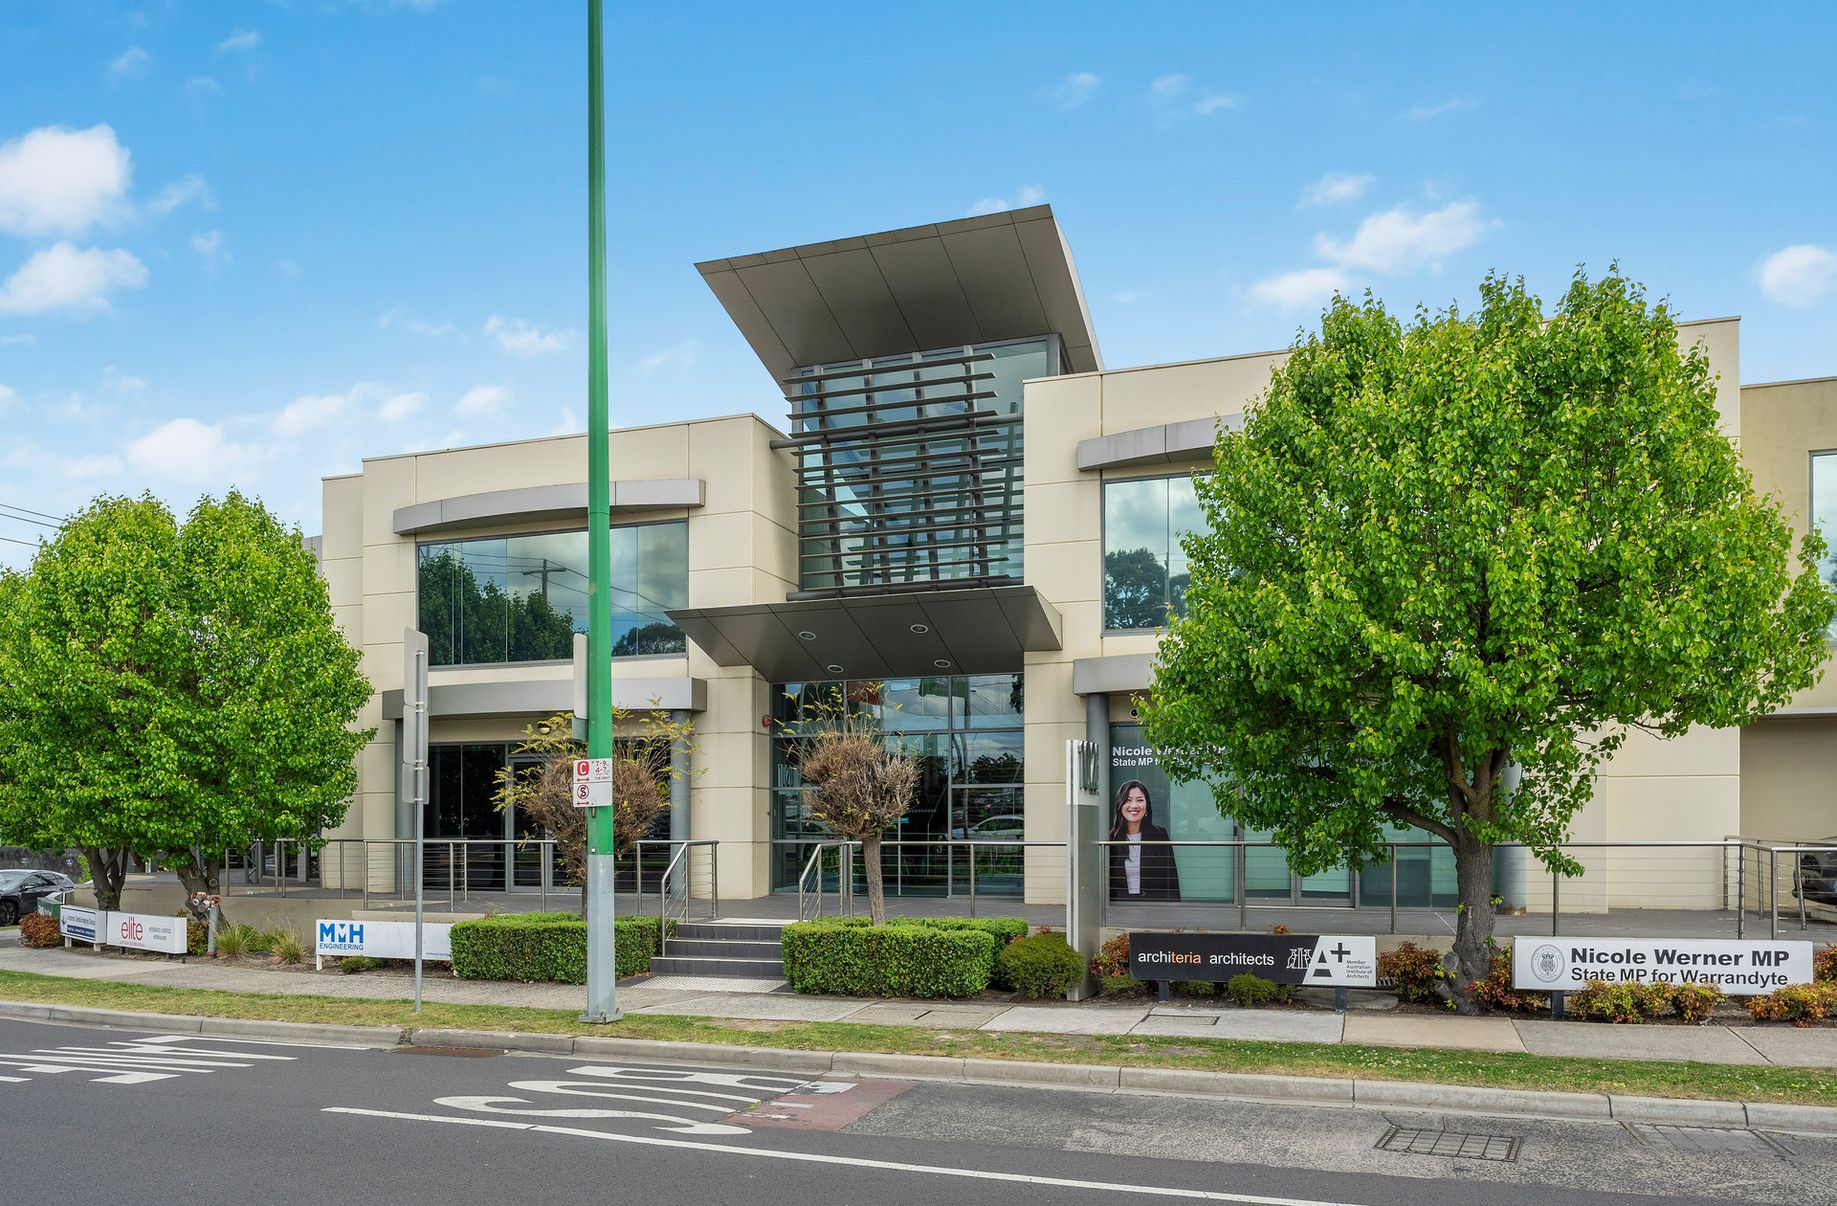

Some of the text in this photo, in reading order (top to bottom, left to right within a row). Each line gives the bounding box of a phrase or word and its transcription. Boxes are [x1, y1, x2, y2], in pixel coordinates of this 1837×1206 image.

[1112, 746, 1153, 756] Nicole
[1112, 757, 1137, 767] State
[1138, 757, 1153, 766] MP
[121, 916, 144, 941] elite
[319, 943, 364, 951] ENGINEERING
[1138, 951, 1275, 966] architeria architects
[1571, 947, 1647, 965] Nicole
[1654, 949, 1744, 966] Werner
[1751, 950, 1790, 967] MP
[1571, 967, 1789, 989] State MP for Warrandyte
